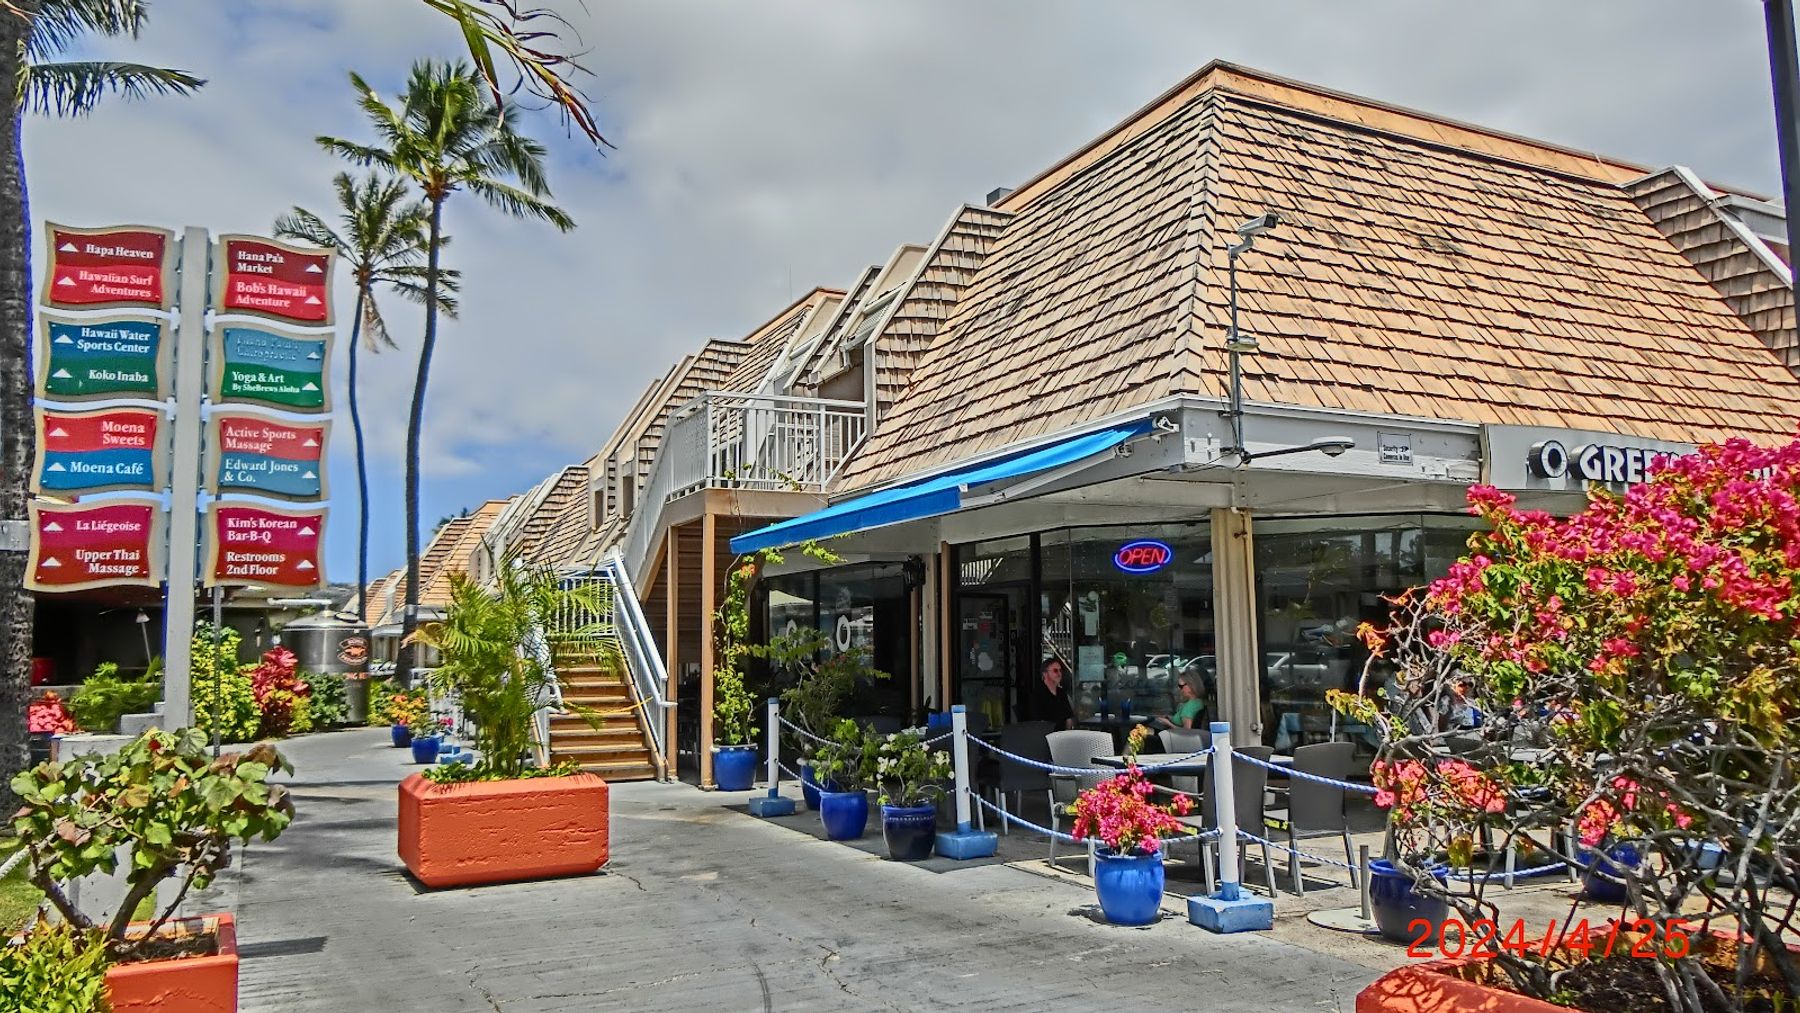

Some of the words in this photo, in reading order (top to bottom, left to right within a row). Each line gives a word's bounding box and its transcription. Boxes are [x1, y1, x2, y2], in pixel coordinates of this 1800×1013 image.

[86, 244, 114, 259] Hapa
[116, 247, 154, 259] Heaven
[238, 251, 264, 262] Hana
[237, 263, 273, 274] Market
[79, 271, 128, 284] Hawaiian
[129, 274, 153, 286] Surf
[90, 284, 151, 297] Adventures
[237, 282, 265, 293] Bob's
[267, 285, 307, 297] Hawaii
[236, 295, 290, 307] Adventure
[81, 328, 118, 339] Hawaii
[120, 330, 150, 341] Water
[77, 340, 112, 352] Sports
[114, 342, 150, 353] Center
[89, 369, 115, 380] Koko
[117, 371, 148, 382] Inaba
[232, 372, 256, 385] Yoga
[258, 373, 266, 382] &
[267, 373, 285, 383] Art
[232, 384, 241, 392] By
[242, 384, 278, 393] SheBrews
[279, 385, 300, 393] Aloha
[102, 422, 145, 434] Moena
[226, 427, 259, 439] Active
[262, 428, 296, 441] Sports
[102, 434, 145, 446] Sweets
[226, 439, 272, 452] Massage
[70, 462, 113, 473] Moena
[116, 462, 144, 475] Café
[225, 459, 267, 471] Edward
[268, 461, 299, 474] Jones
[224, 471, 234, 482] &
[238, 472, 256, 482] Co.
[76, 521, 90, 530] La
[91, 520, 141, 534] Liégeoise
[227, 518, 257, 528] Kim's
[258, 519, 297, 529] Korean
[227, 531, 272, 544] Bar-B-Q
[76, 550, 112, 562] Upper
[113, 550, 140, 560] Thai
[227, 552, 286, 562] Restrooms
[1119, 546, 1167, 566] OPEN
[89, 563, 139, 576] Massage
[227, 564, 249, 574] 2nd
[250, 564, 279, 575] Floor
